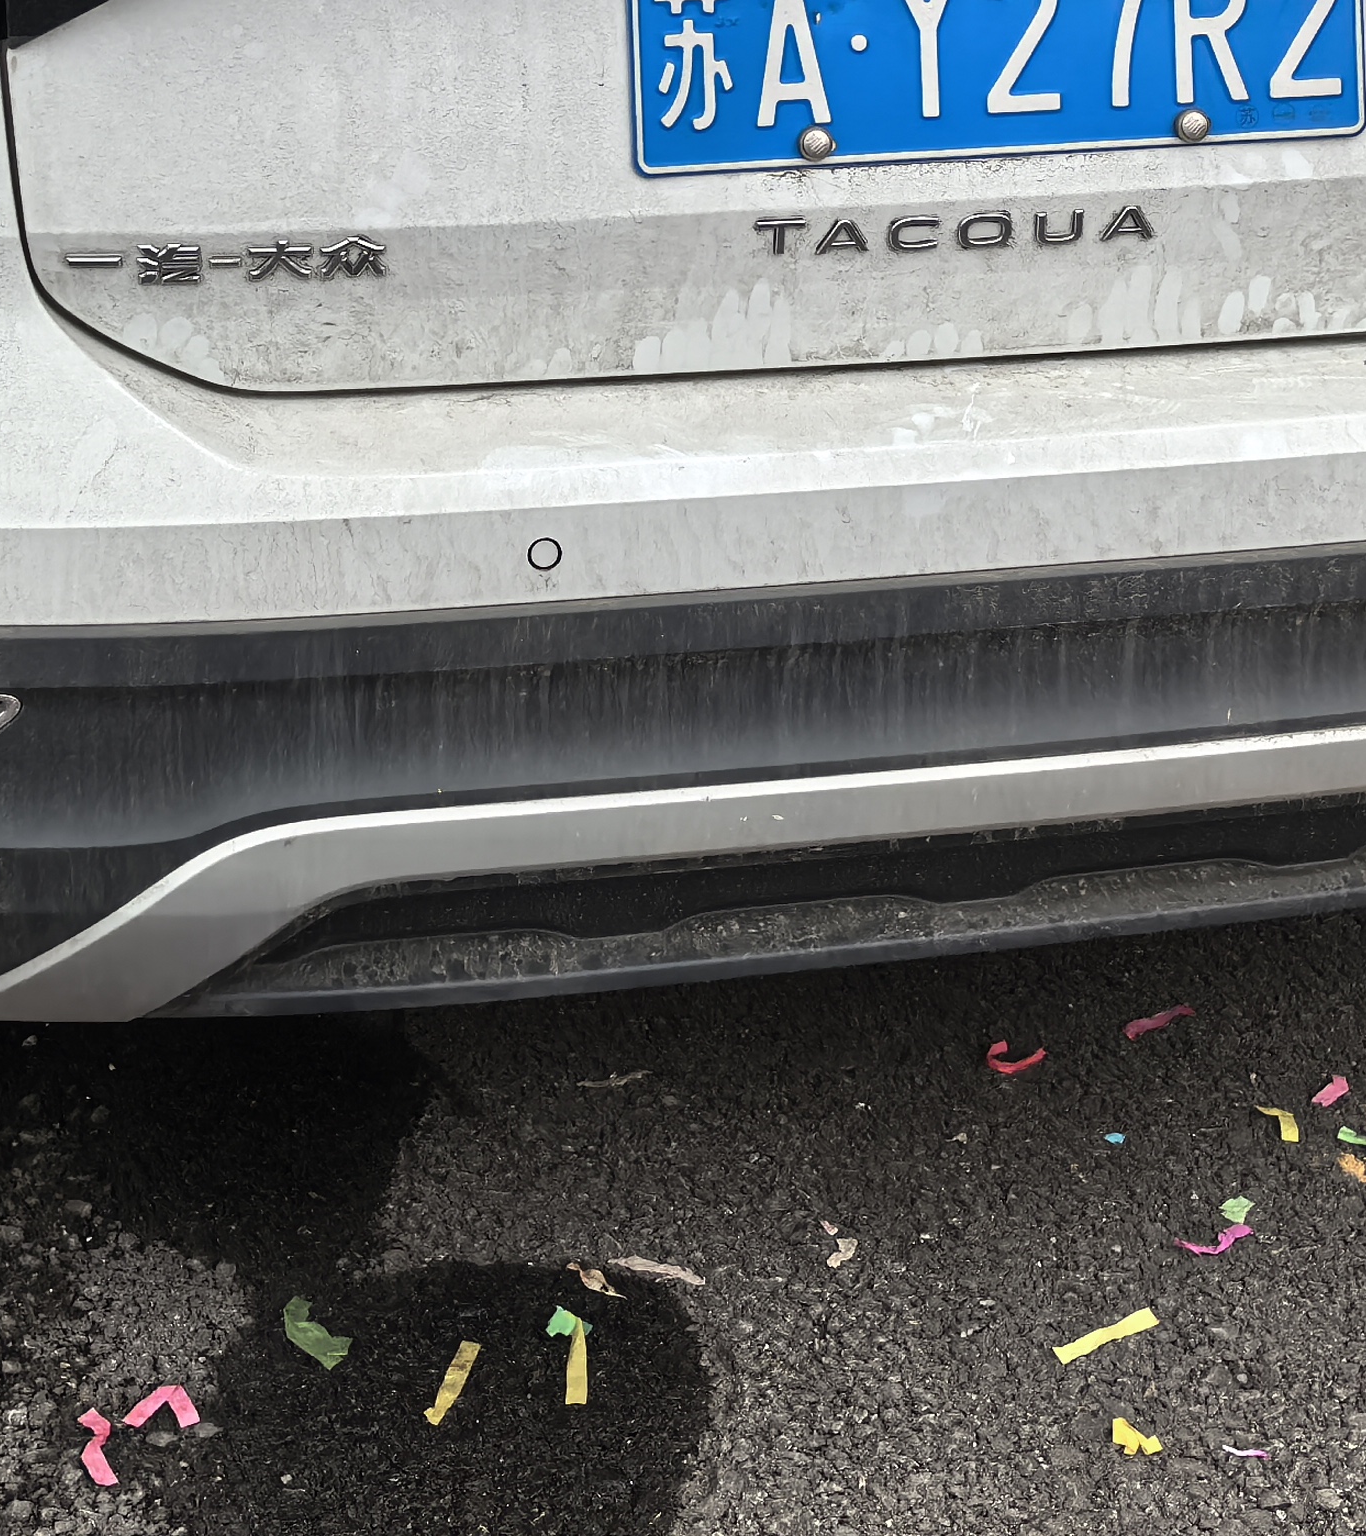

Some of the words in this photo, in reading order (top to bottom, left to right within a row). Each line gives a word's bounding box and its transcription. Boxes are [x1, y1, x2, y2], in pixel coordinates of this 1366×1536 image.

[754, 204, 1155, 255] TACQUA
[64, 234, 388, 285] 一汽-大众
